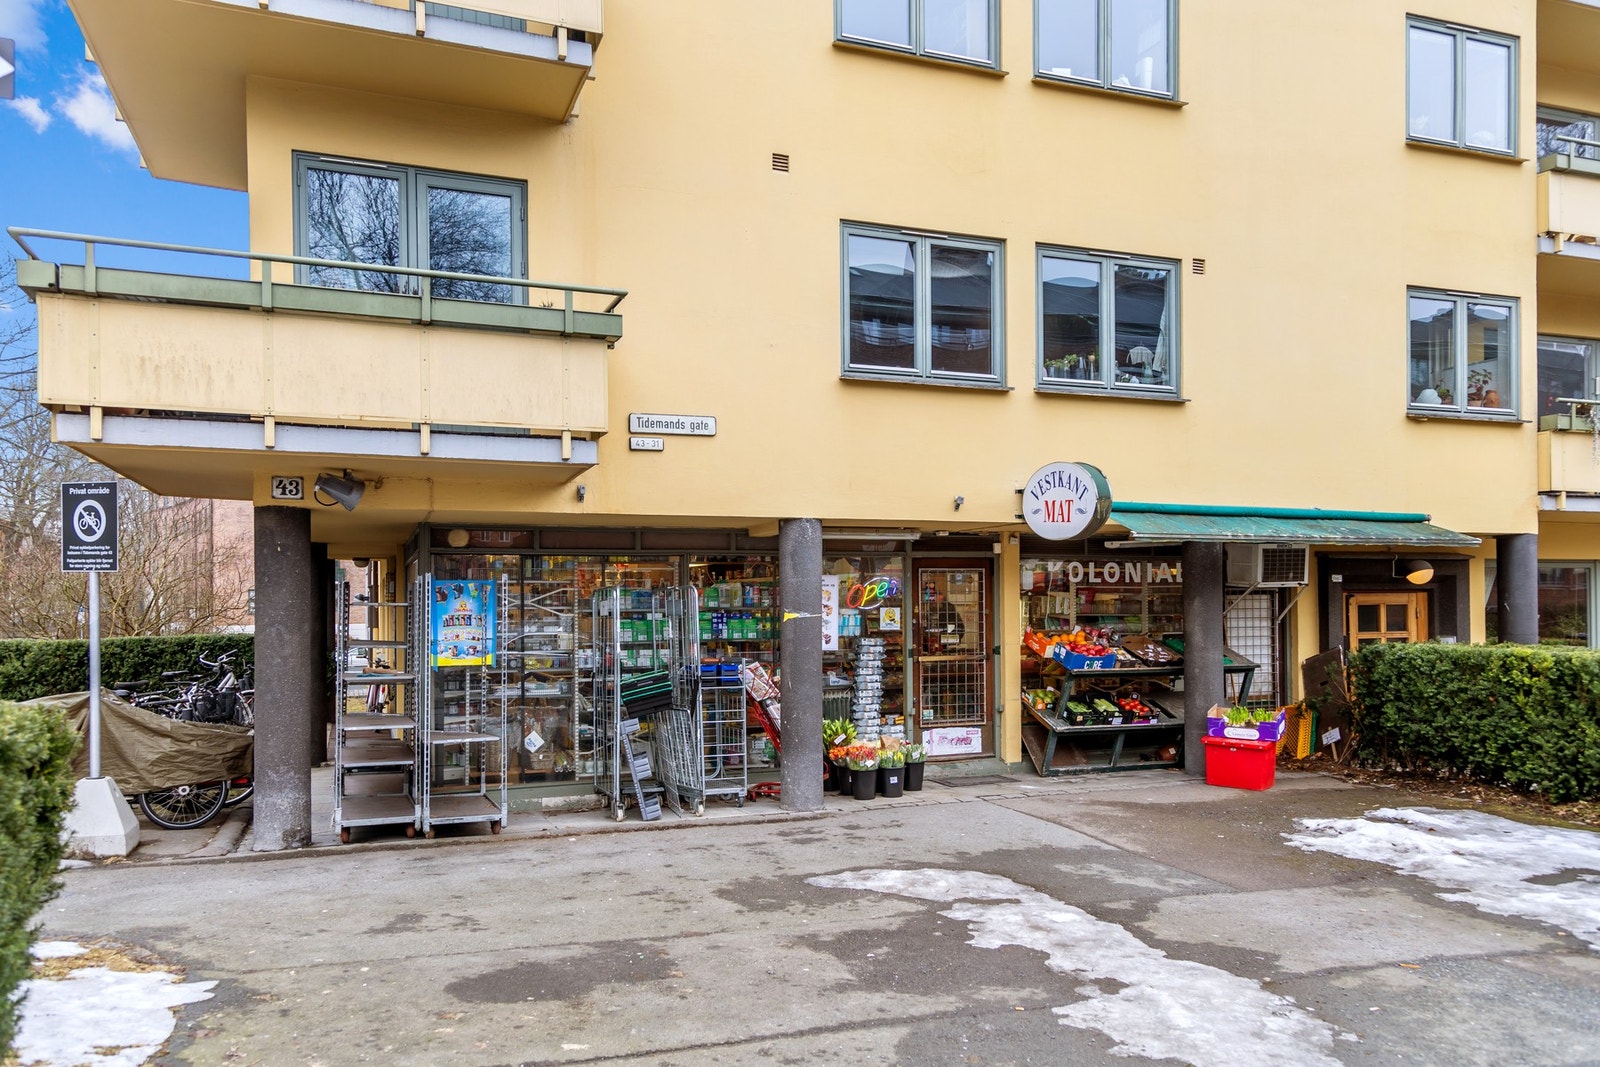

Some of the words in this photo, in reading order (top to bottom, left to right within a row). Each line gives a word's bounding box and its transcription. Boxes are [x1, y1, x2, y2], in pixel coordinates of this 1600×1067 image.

[636, 416, 686, 430] Tidemands
[690, 420, 709, 433] gate
[69, 487, 87, 495] Privat
[87, 486, 110, 495] område
[275, 479, 301, 496] 43
[1030, 470, 1089, 501] VESTKANT
[1043, 499, 1074, 523] MAT
[846, 578, 898, 608] Open
